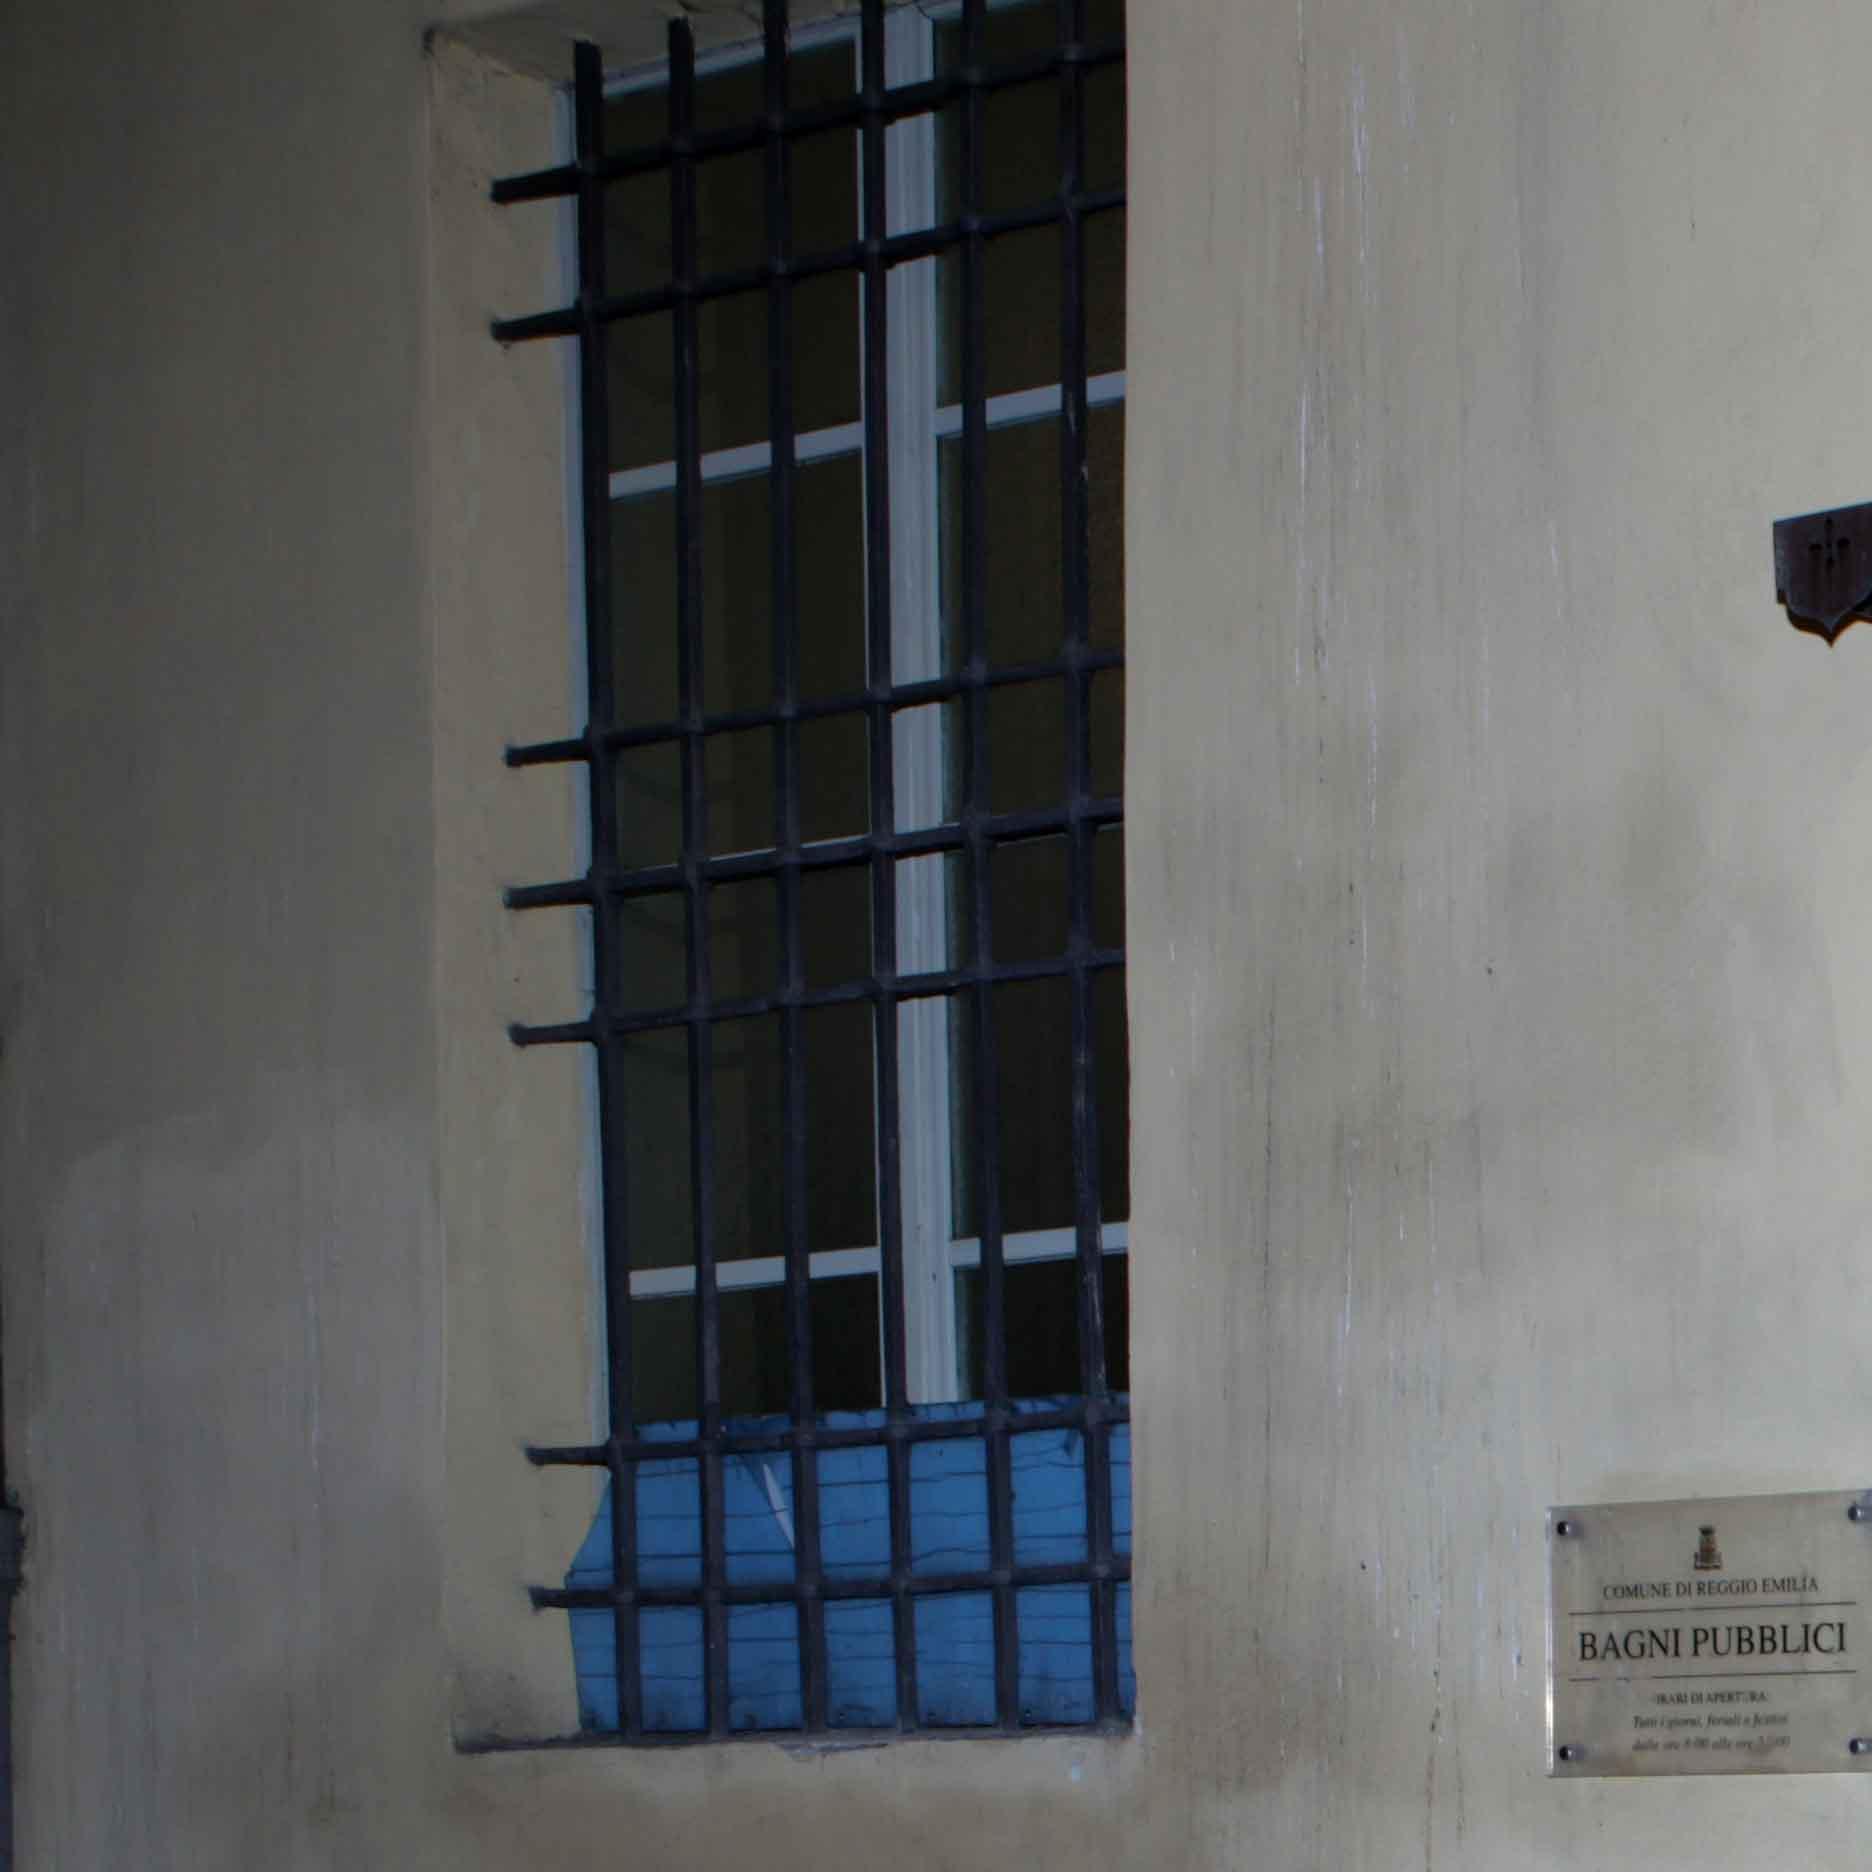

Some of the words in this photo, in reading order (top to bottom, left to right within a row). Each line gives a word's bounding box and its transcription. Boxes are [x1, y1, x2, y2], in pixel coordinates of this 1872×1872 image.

[1603, 1582, 1671, 1600] COMUNE
[1675, 1581, 1692, 1598] DI
[1696, 1578, 1758, 1597] REGGIO
[1761, 1575, 1819, 1594] EMILIA
[1579, 1628, 1681, 1661] BAGNI
[1691, 1622, 1846, 1657] PUBBLICI
[1706, 1689, 1768, 1704] APERTRA
